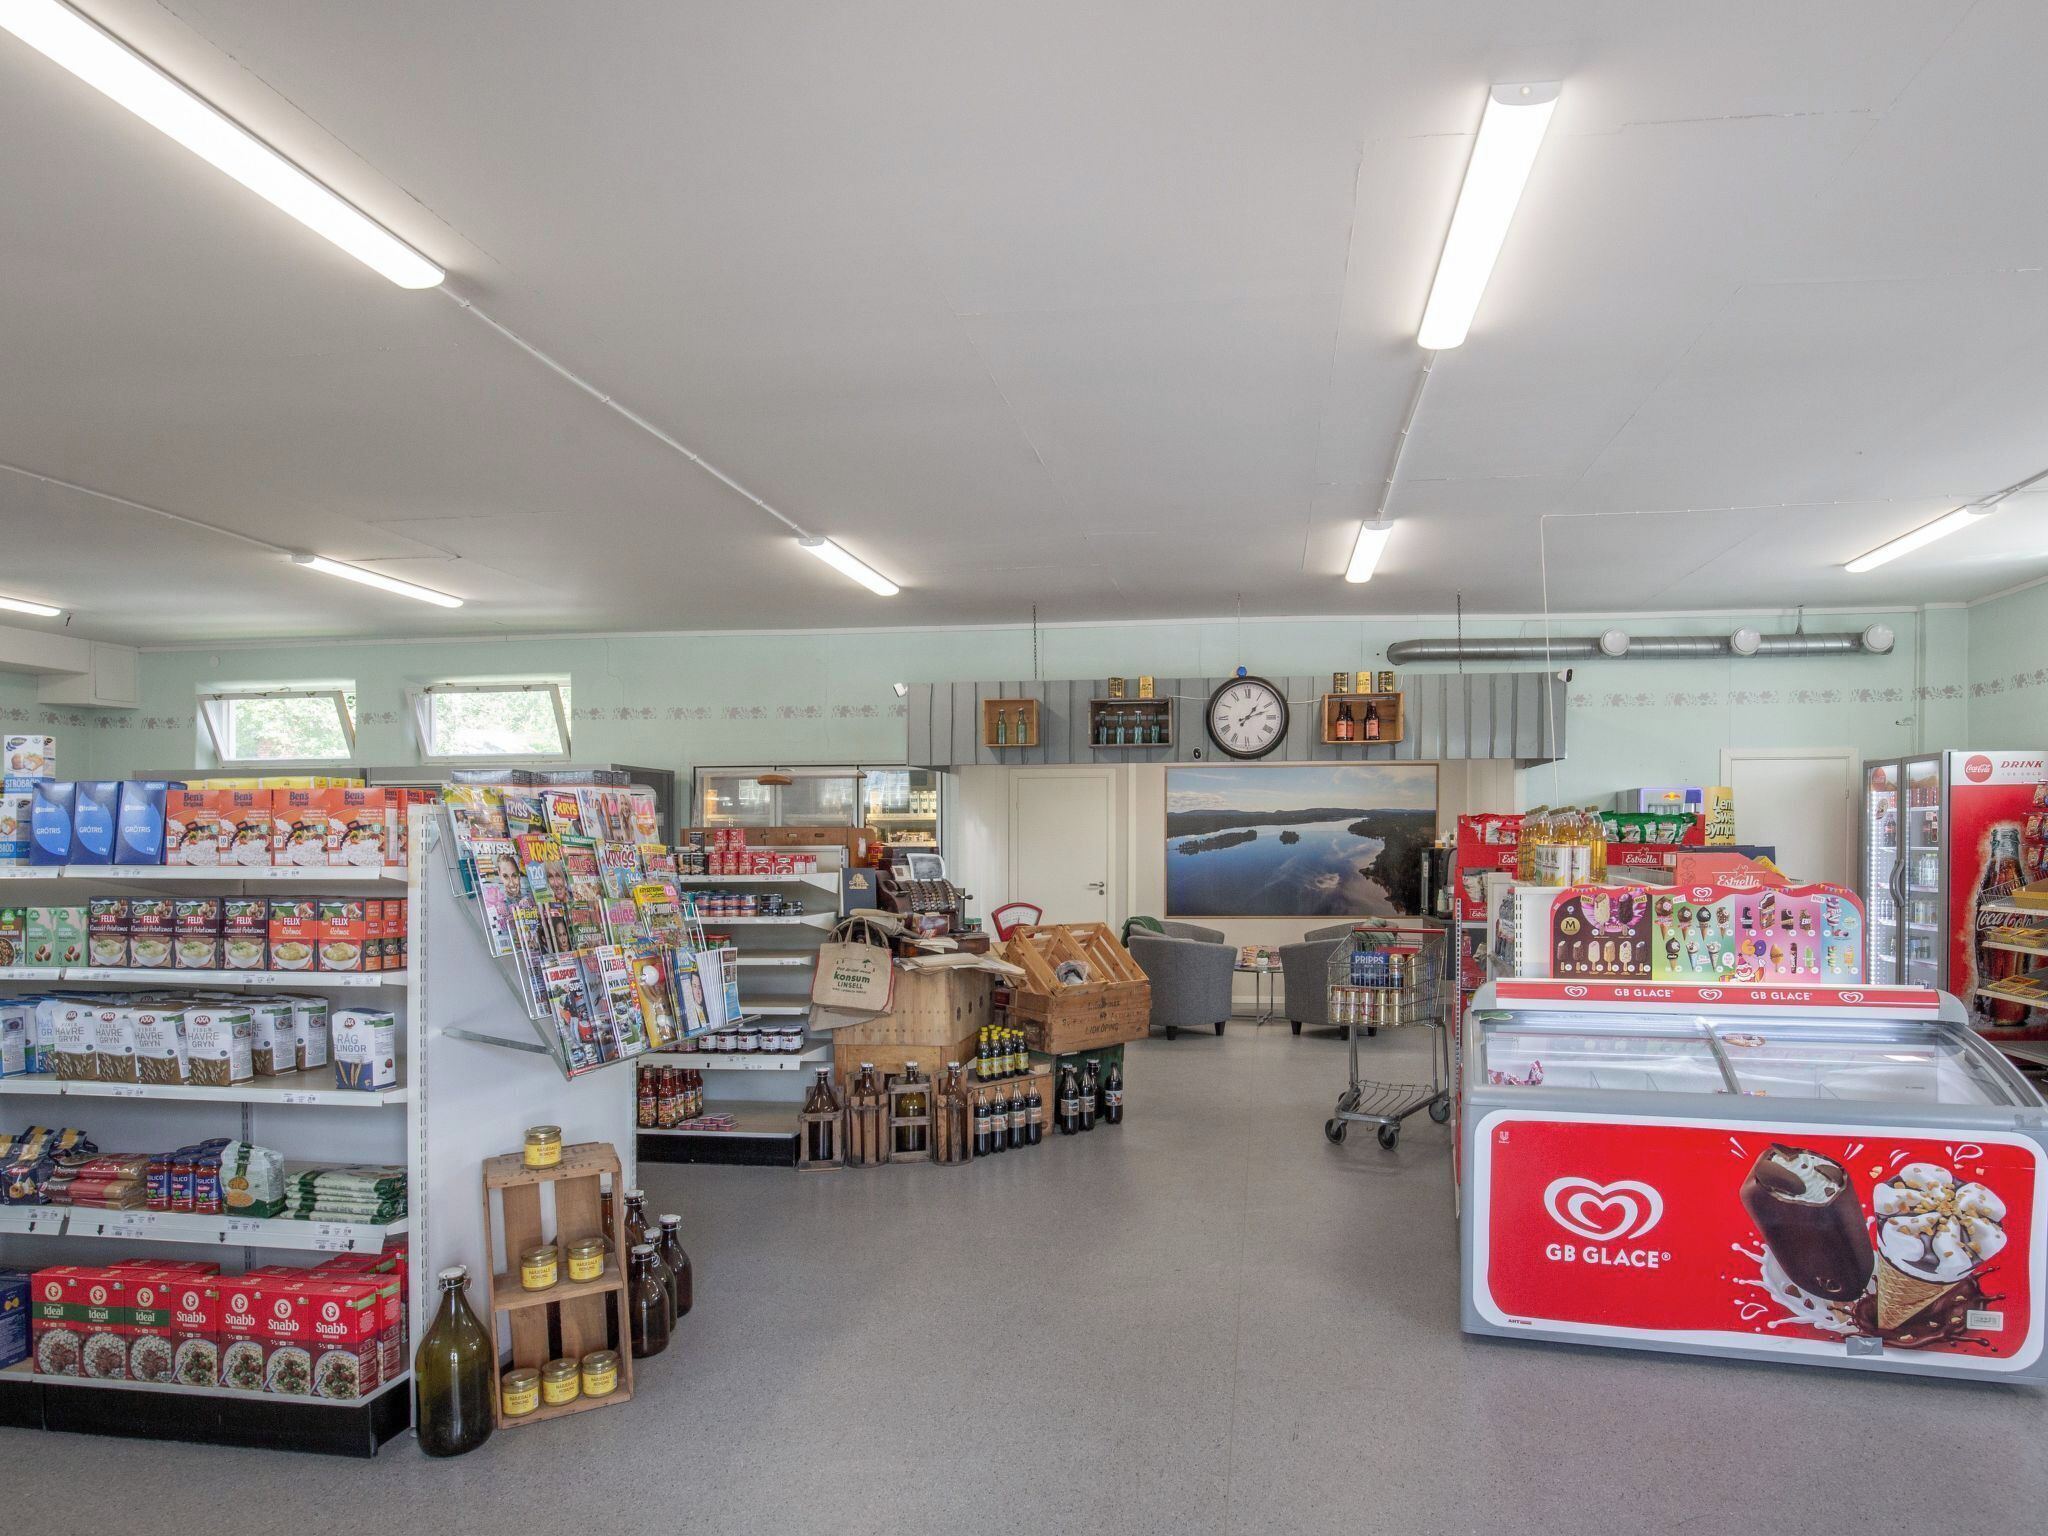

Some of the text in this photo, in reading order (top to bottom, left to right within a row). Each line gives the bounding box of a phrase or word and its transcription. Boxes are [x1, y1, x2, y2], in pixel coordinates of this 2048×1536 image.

[1965, 763, 1991, 774] Coca-Cola
[2000, 760, 2044, 768] DRINK
[183, 792, 204, 801] Ben's
[234, 791, 253, 801] Ben's
[289, 791, 309, 801] Ben's
[344, 790, 365, 800] Ben's
[1712, 795, 1734, 811] Lem
[556, 802, 577, 816] KRYS
[1713, 810, 1734, 824] Swe
[36, 826, 61, 835] GRÖTRIS
[79, 825, 103, 834] GRÖTRIS
[125, 825, 151, 834] GRÖTRIS
[1705, 822, 1736, 839] Symp
[527, 841, 561, 863] KRYSS
[604, 849, 636, 869] KRYSS
[1501, 854, 1518, 864] Estr
[1625, 854, 1657, 864] Estrella
[527, 866, 544, 880] 120
[1716, 875, 1760, 887] Estrella
[101, 915, 116, 923] FELIX
[143, 915, 160, 924] FELIX
[187, 916, 204, 925] FELIX
[236, 916, 253, 925] FELIX
[283, 917, 300, 926] FELIX
[331, 917, 348, 926] FELIX
[1565, 920, 1576, 929] M
[1354, 954, 1385, 966] PRIPPS
[833, 971, 871, 984] konsum
[837, 981, 864, 989] LINSELL
[1614, 988, 1629, 996] GB
[1751, 991, 1767, 999] GB
[55, 1027, 84, 1036] HAVRE
[96, 1028, 123, 1037] HAVRE
[134, 1031, 164, 1040] HAVRE
[187, 1031, 220, 1040] HAVRE
[337, 1033, 358, 1043] RÅG
[139, 1040, 161, 1048] GRYN
[191, 1040, 215, 1048] GRYN
[334, 1044, 367, 1053] FLINGOR
[1546, 1243, 1576, 1262] GB
[43, 1306, 64, 1316] Ideal
[88, 1310, 109, 1320] Ideal
[135, 1312, 155, 1322] Ideal
[176, 1310, 206, 1324] Snabb
[225, 1313, 256, 1326] Snabb
[267, 1319, 300, 1332] Snabb
[315, 1322, 348, 1335] Snabb
